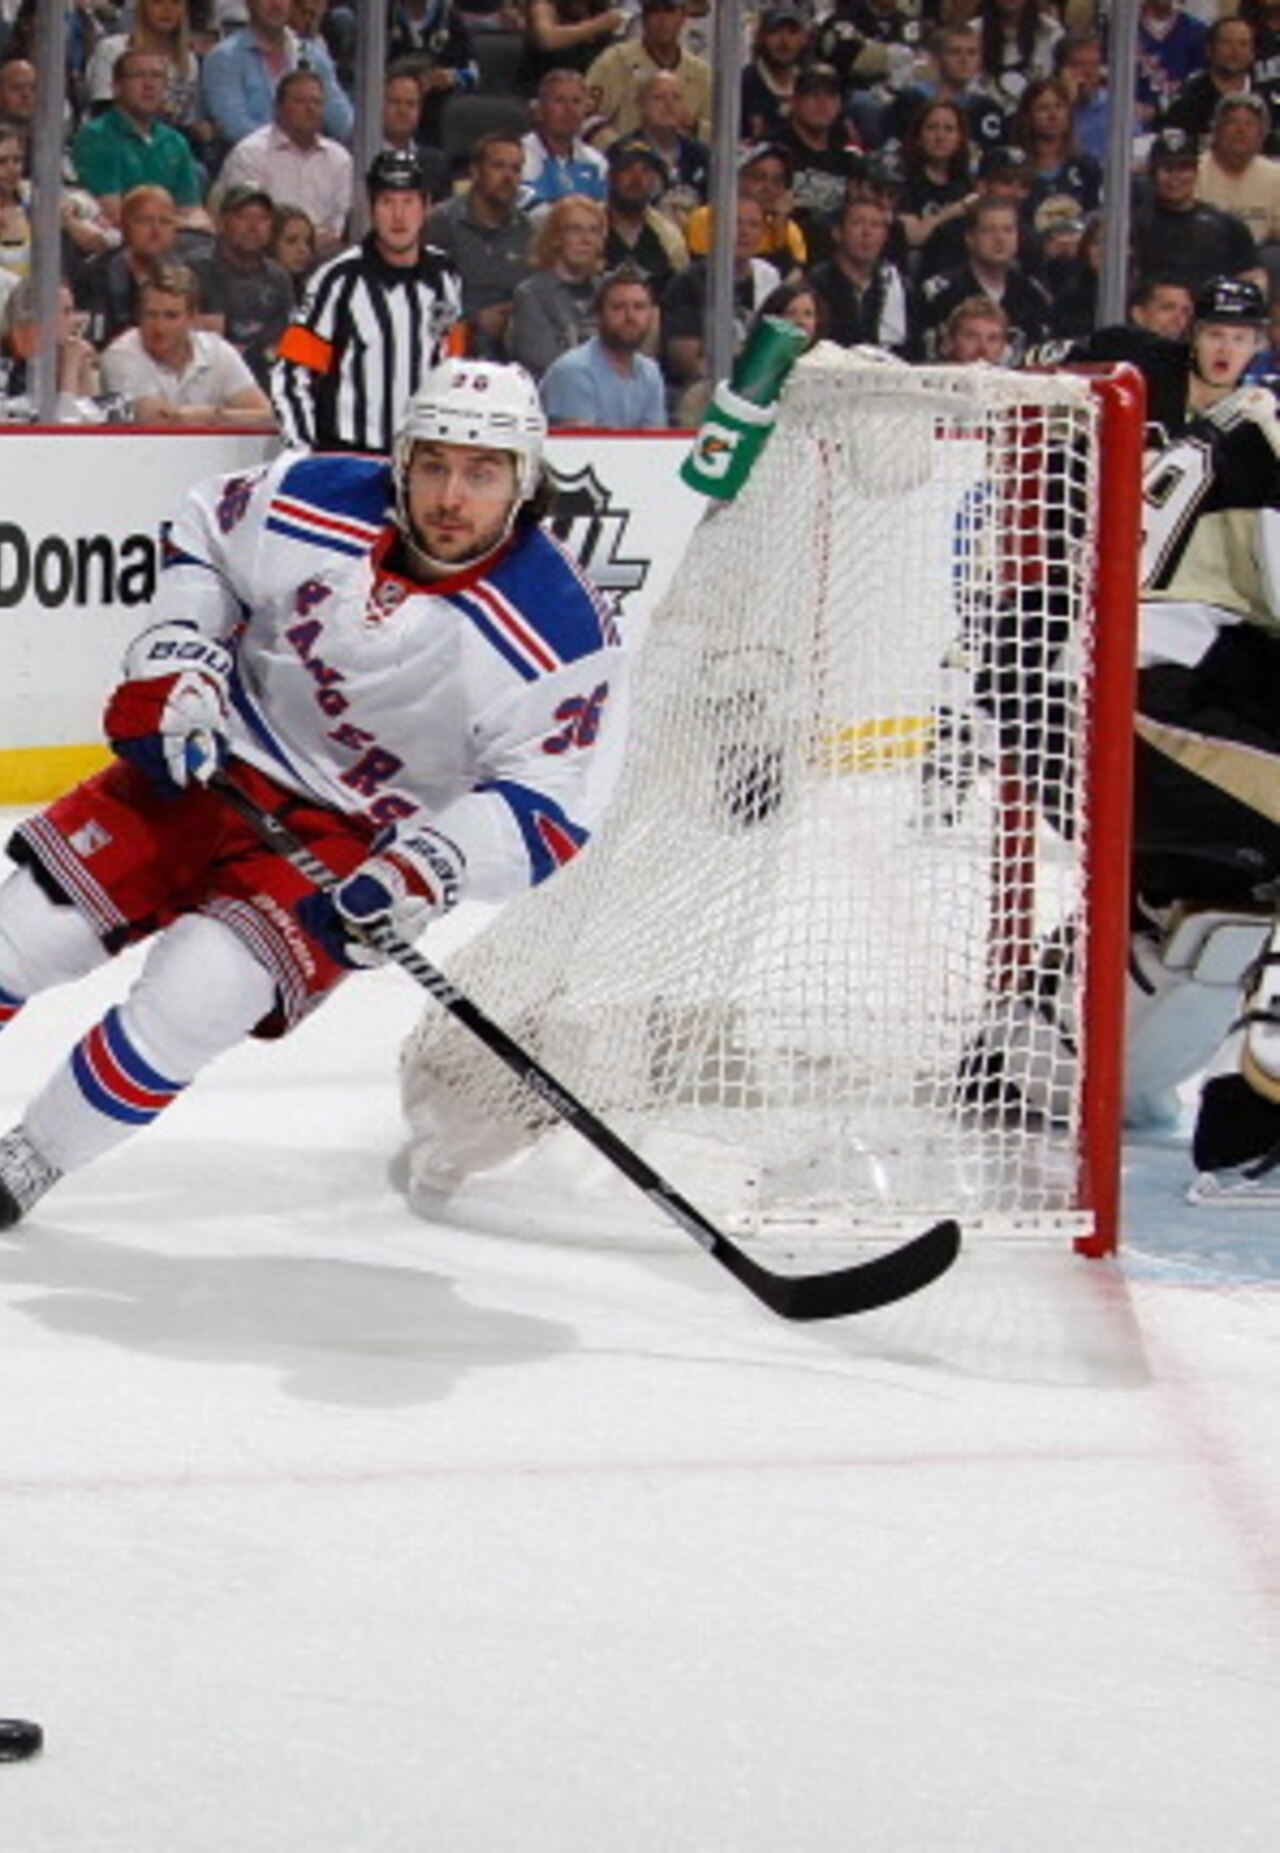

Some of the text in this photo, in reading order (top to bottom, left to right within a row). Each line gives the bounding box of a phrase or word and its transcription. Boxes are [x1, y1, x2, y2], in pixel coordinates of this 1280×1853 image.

[692, 421, 741, 479] G
[284, 576, 420, 830] RANGERS
[542, 680, 609, 755] 36
